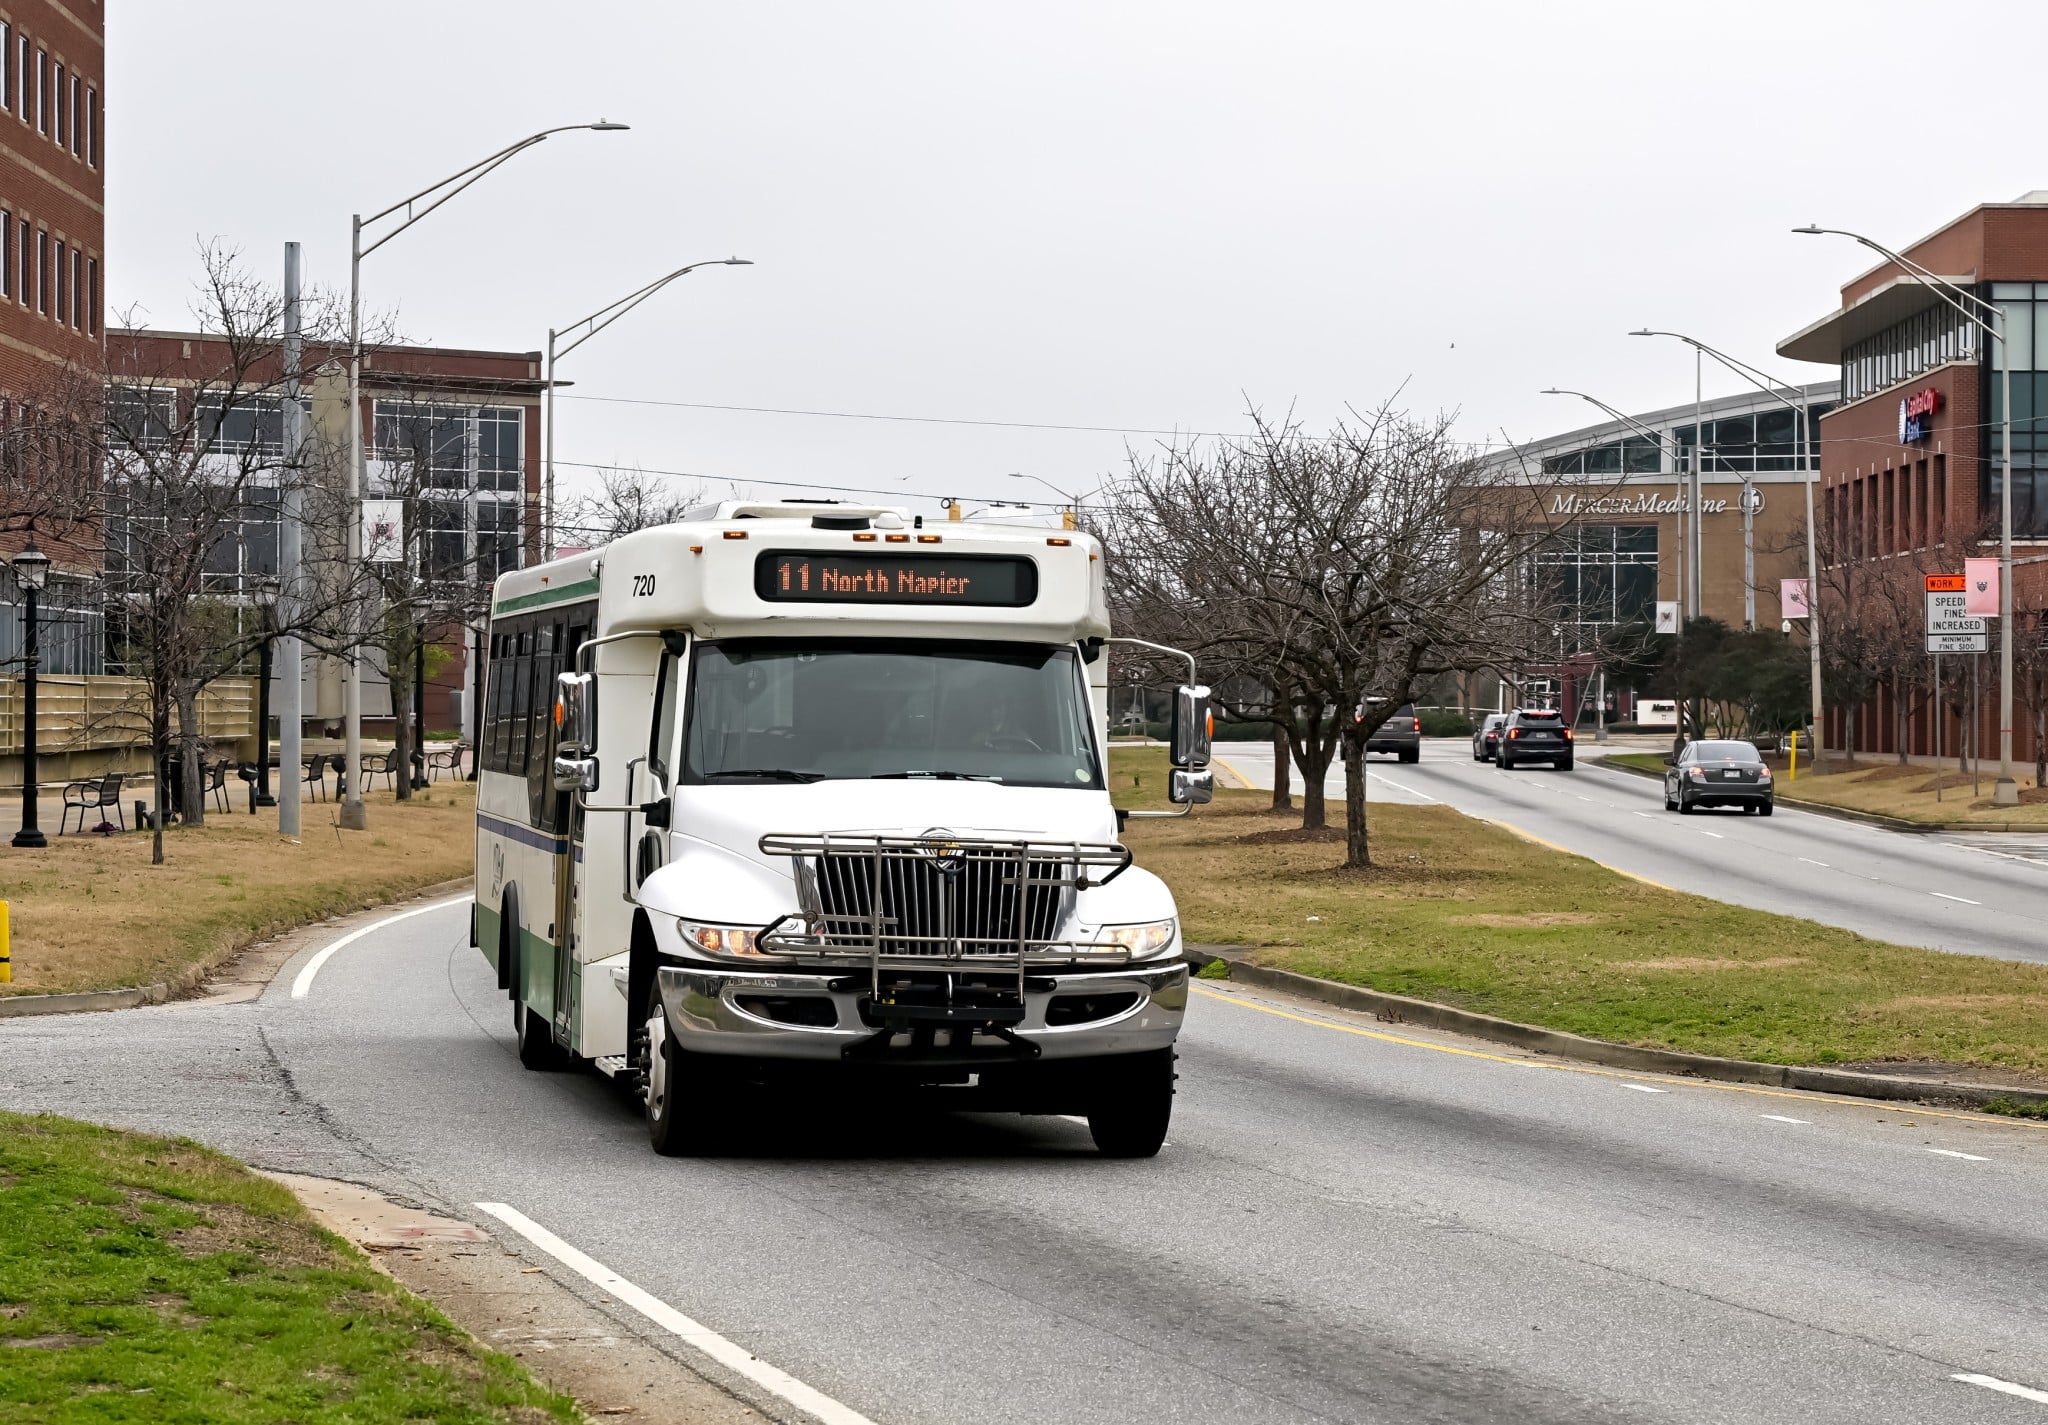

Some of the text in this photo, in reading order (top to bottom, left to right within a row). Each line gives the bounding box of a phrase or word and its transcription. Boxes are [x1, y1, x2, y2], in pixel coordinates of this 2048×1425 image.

[1633, 492, 1727, 514] Medine
[632, 574, 656, 598] 720
[778, 562, 970, 594] 11 North Napier
[1929, 579, 1953, 588] WORK
[1935, 597, 1966, 607] SPEEDI
[1932, 621, 1981, 630] INCREASED
